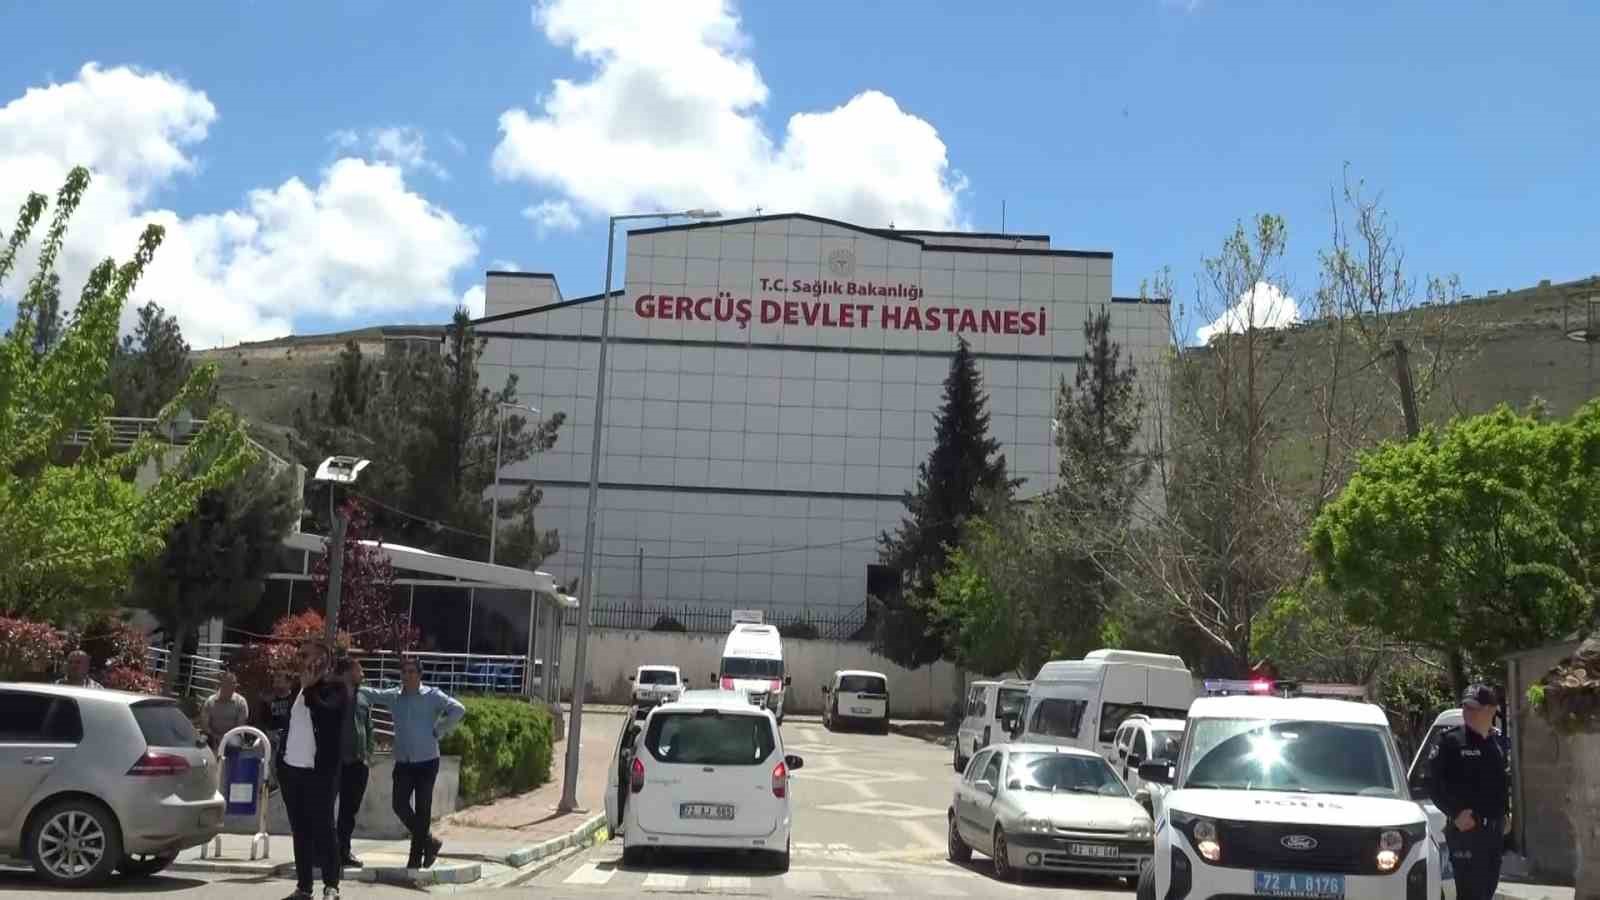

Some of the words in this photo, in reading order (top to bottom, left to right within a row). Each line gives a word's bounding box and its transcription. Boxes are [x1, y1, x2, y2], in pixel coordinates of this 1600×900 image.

[760, 278, 788, 292] T.C.
[792, 279, 843, 298] Sağlık
[848, 282, 923, 301] Bakanlığı
[635, 293, 752, 329] GERCÜŞ
[760, 299, 874, 329] DEVLET
[881, 304, 1047, 336] HASTANESİ
[1263, 873, 1280, 889] 72
[1289, 874, 1297, 890] A
